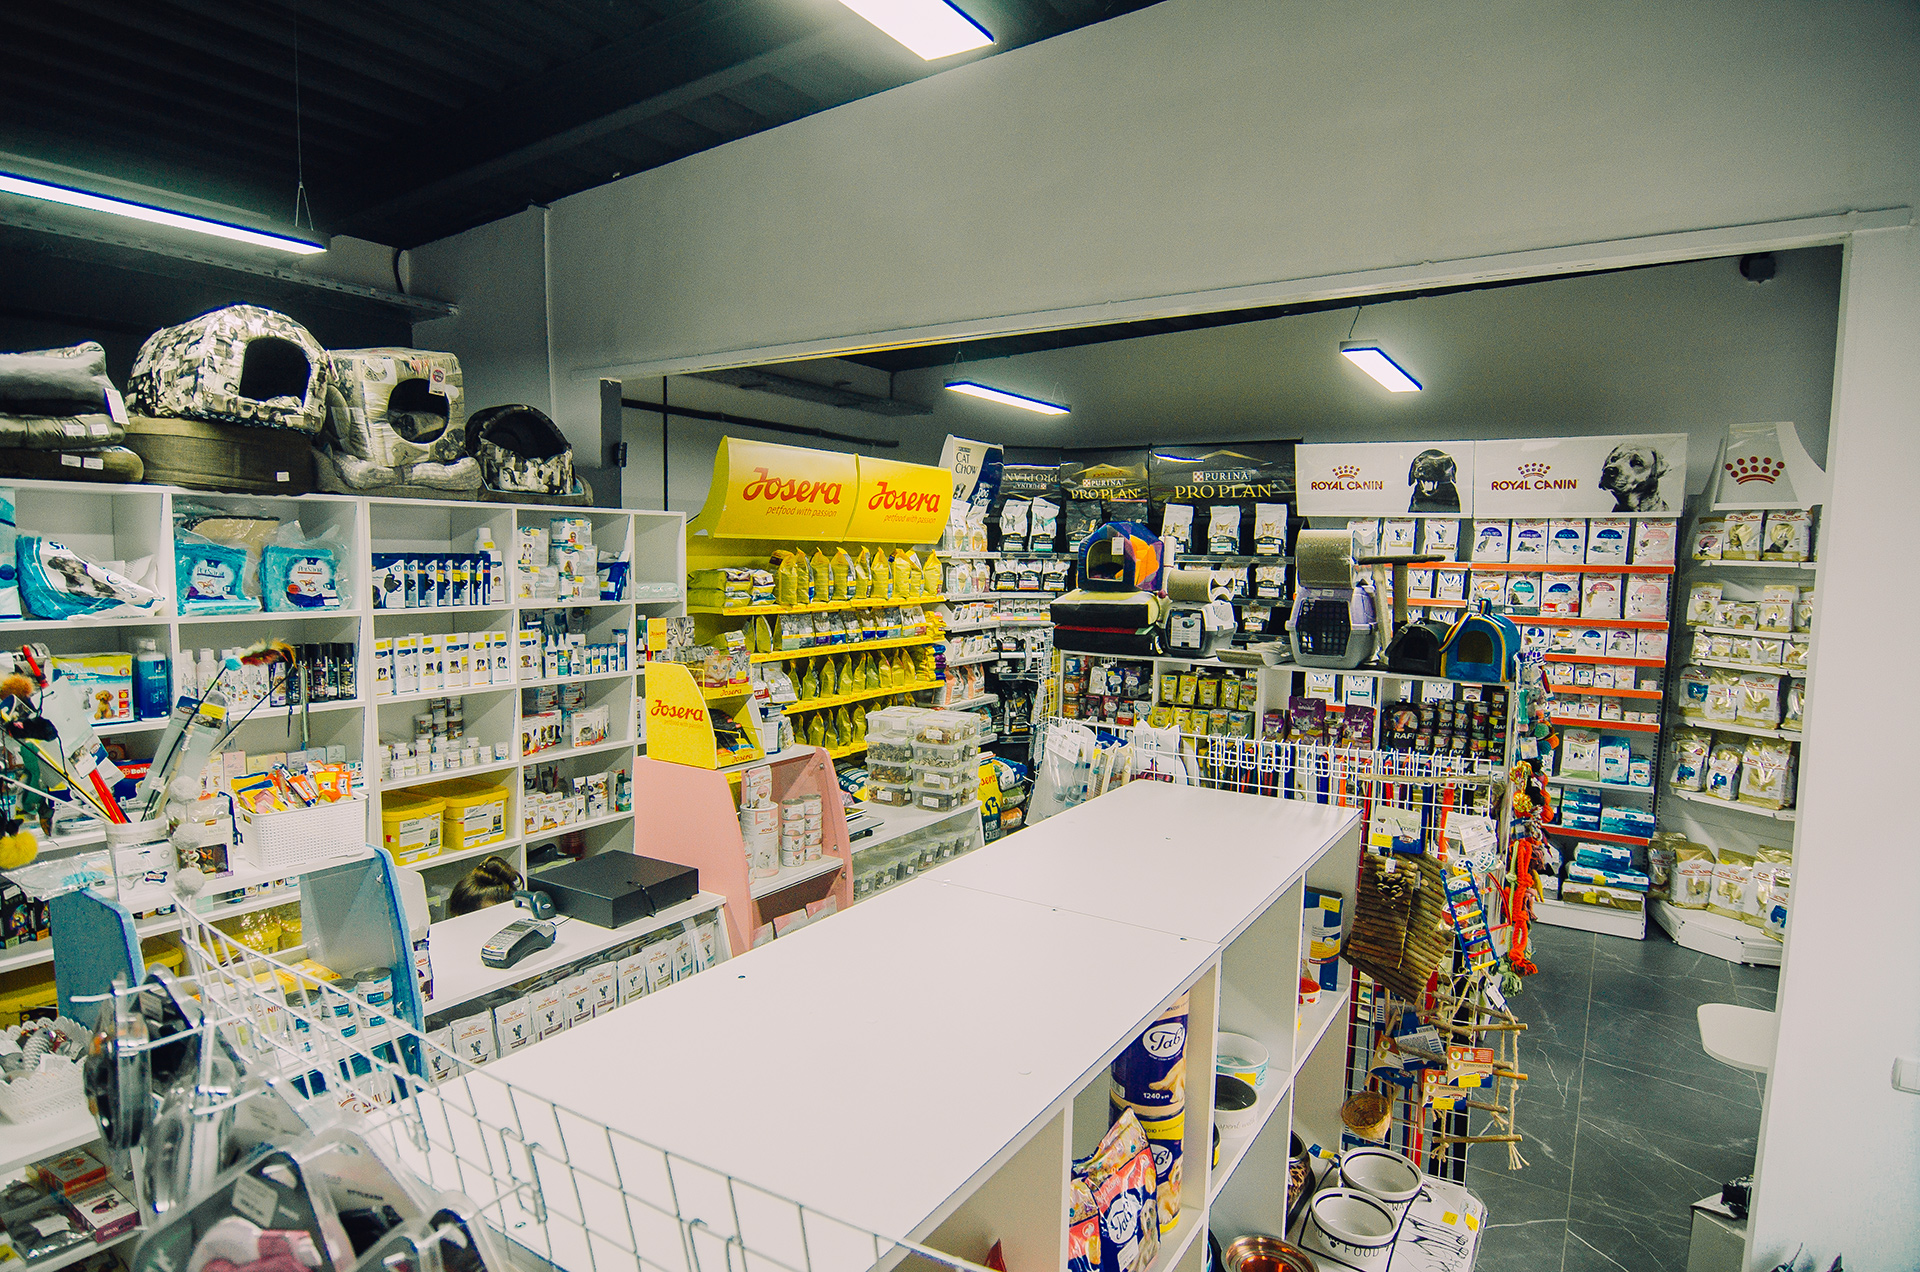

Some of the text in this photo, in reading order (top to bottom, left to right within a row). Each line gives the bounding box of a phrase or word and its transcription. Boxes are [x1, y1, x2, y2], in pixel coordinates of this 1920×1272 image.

[956, 452, 970, 464] CAT
[955, 462, 977, 475] CHOW
[1204, 472, 1250, 481] PURINA
[742, 466, 842, 505] Josera
[1090, 479, 1123, 487] PURINA
[1310, 480, 1383, 491] ROYAL CANIN
[1490, 479, 1578, 491] ROYAL CANIN
[868, 481, 941, 513] Josera
[1071, 487, 1138, 500] PRO PLAN
[1174, 484, 1272, 499] PRO PLAN
[766, 504, 837, 519] petfood with passion
[720, 688, 742, 697] Josera
[650, 699, 704, 722] Josera
[732, 753, 754, 763] Josera
[1143, 1092, 1161, 1100] 1240
[1344, 1244, 1380, 1258] FOOD
